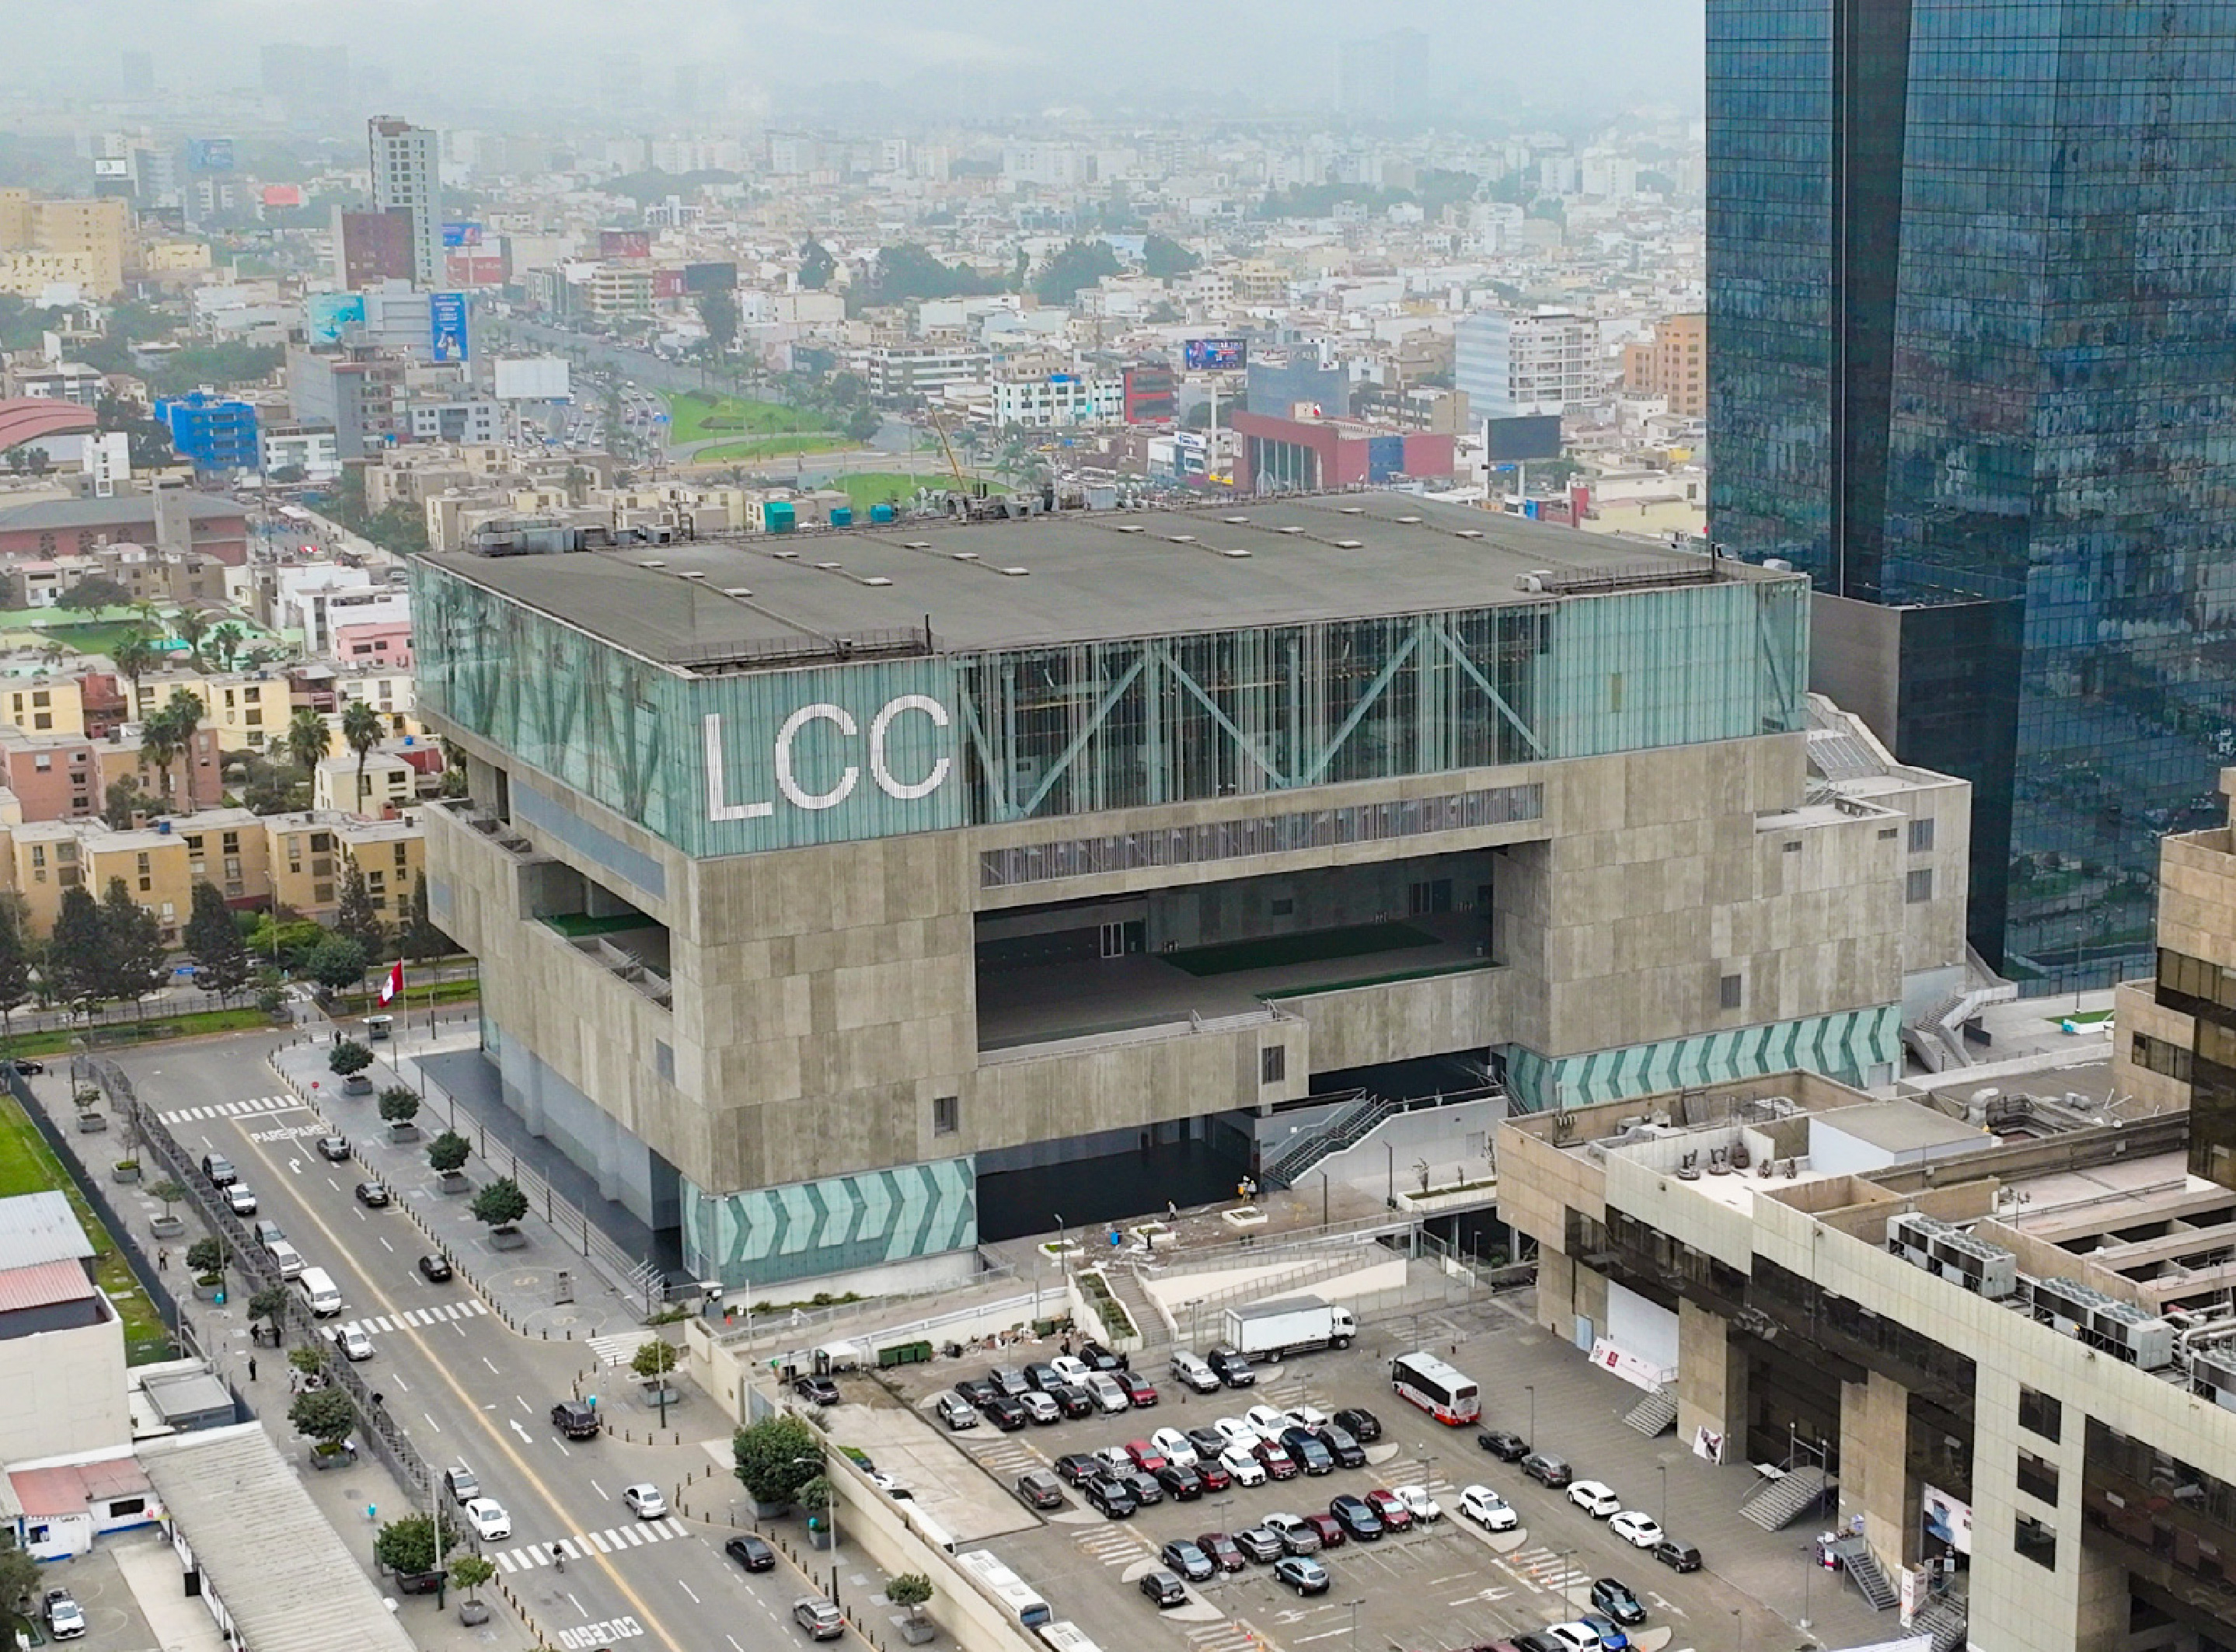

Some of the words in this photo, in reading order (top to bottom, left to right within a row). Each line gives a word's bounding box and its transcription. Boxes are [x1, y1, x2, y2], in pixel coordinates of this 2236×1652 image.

[704, 694, 950, 821] LCC
[250, 1129, 290, 1143] PARE
[286, 1124, 327, 1139] PARE
[559, 1616, 644, 1649] COLEGIO
